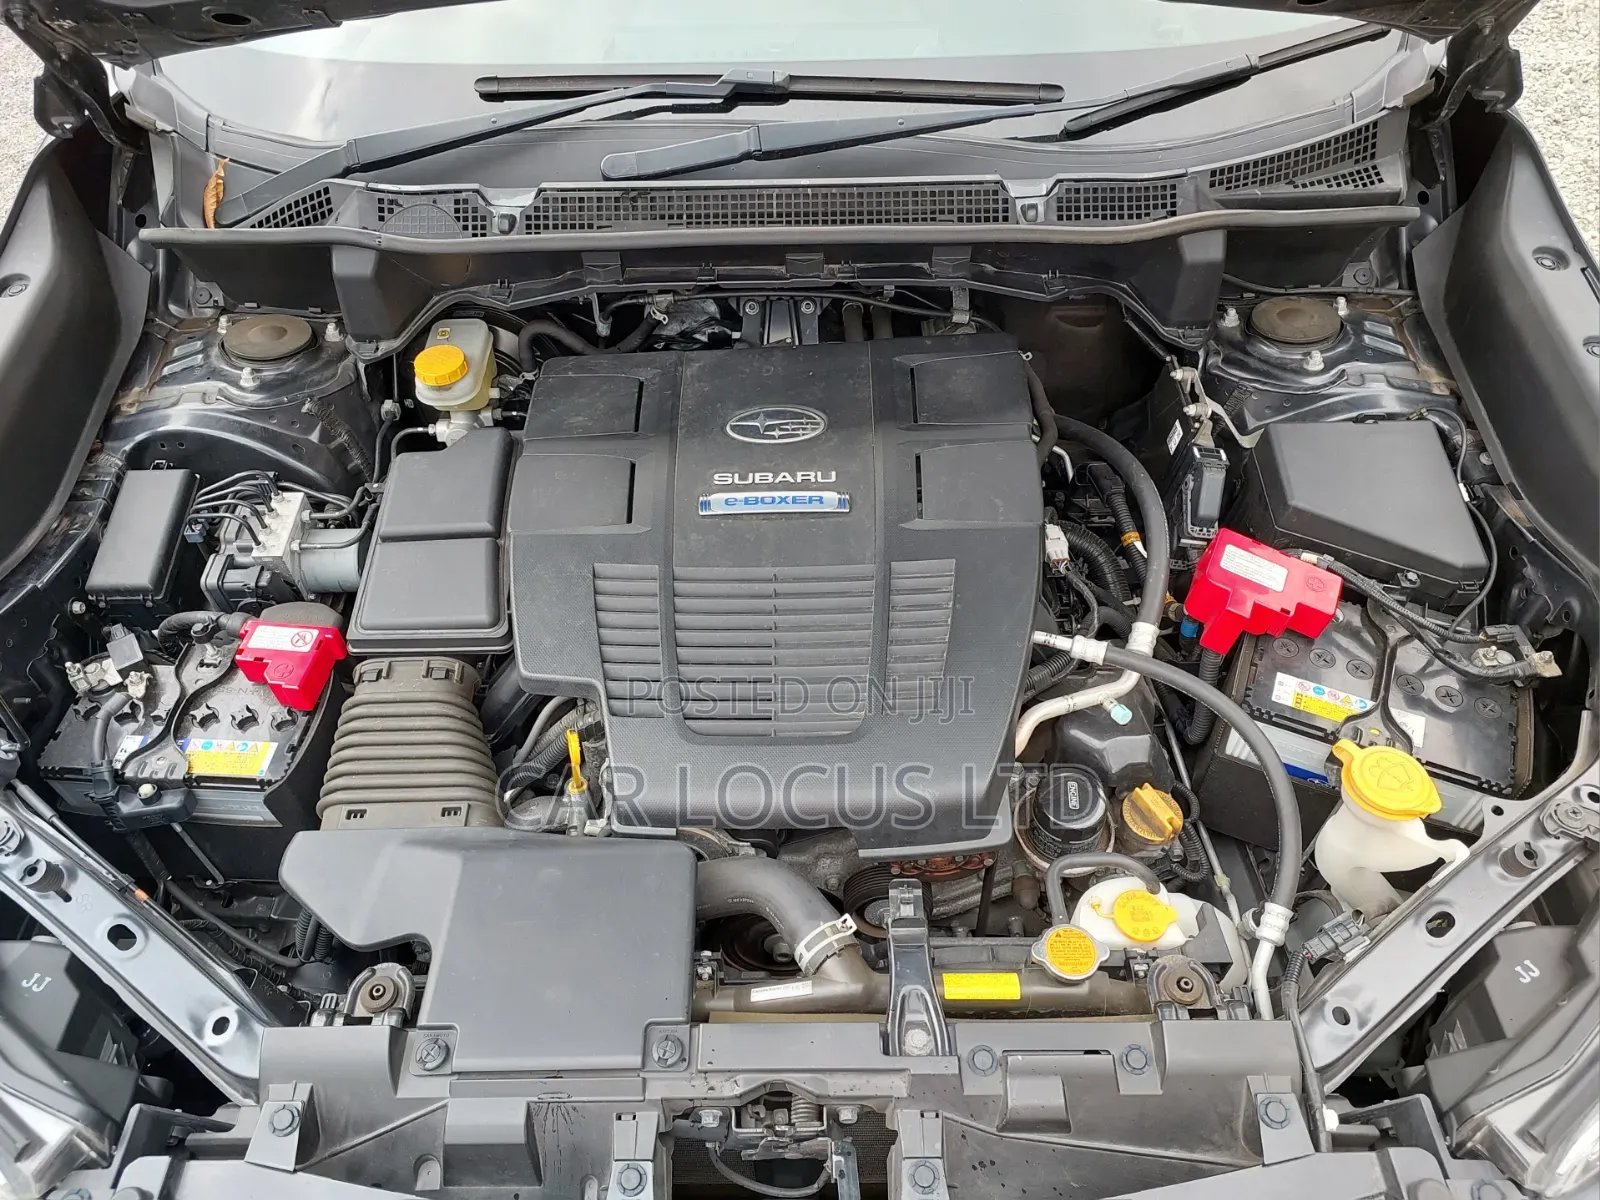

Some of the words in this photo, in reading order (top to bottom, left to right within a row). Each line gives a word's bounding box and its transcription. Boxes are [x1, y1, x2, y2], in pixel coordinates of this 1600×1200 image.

[713, 470, 837, 485] SUBARU
[724, 495, 825, 507] e-BOXER
[1068, 782, 1079, 809] ENGINE
[1514, 959, 1541, 984] JJ
[21, 972, 52, 992] JJ
